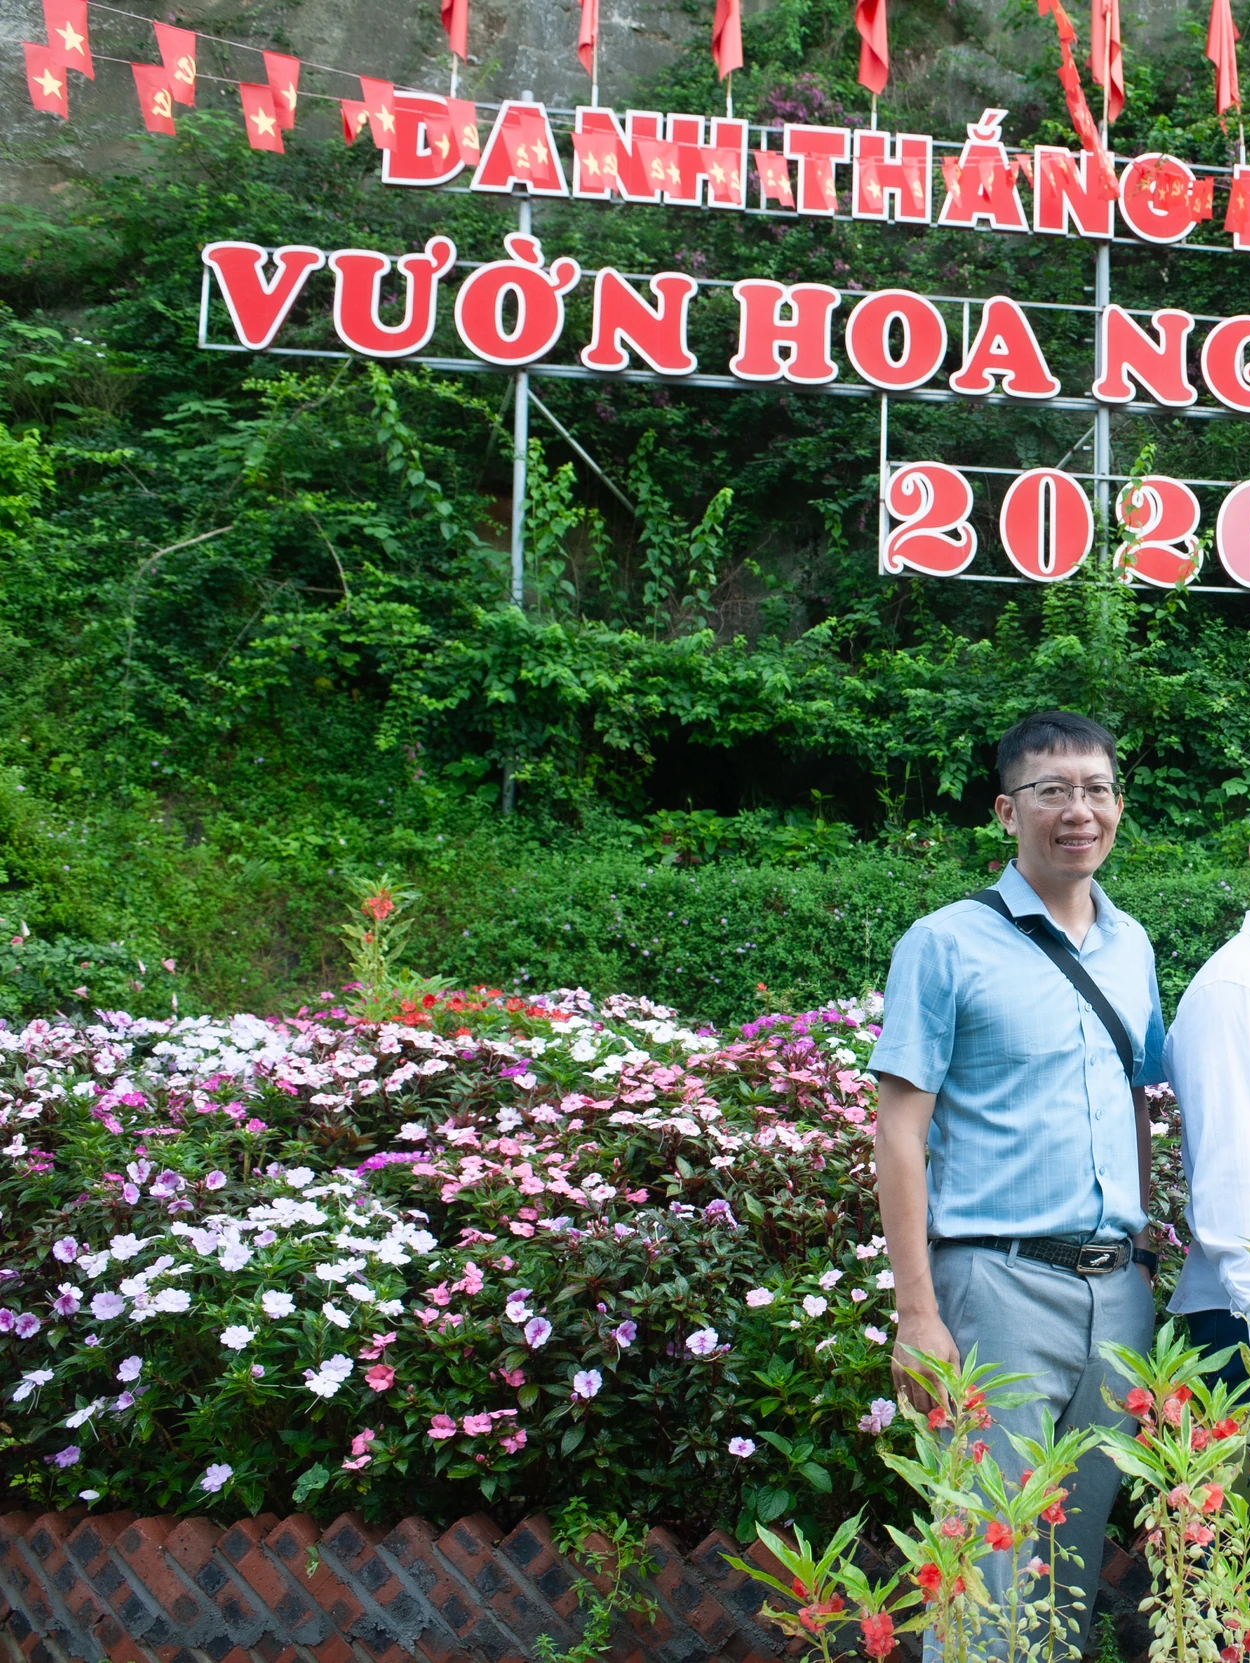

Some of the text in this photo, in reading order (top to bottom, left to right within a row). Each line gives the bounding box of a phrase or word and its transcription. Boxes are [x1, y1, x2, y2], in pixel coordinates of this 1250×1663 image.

[381, 90, 749, 210] DANH
[783, 107, 1197, 245] THẮNG
[202, 232, 698, 377] VƯỜN
[729, 279, 1062, 399] HOA
